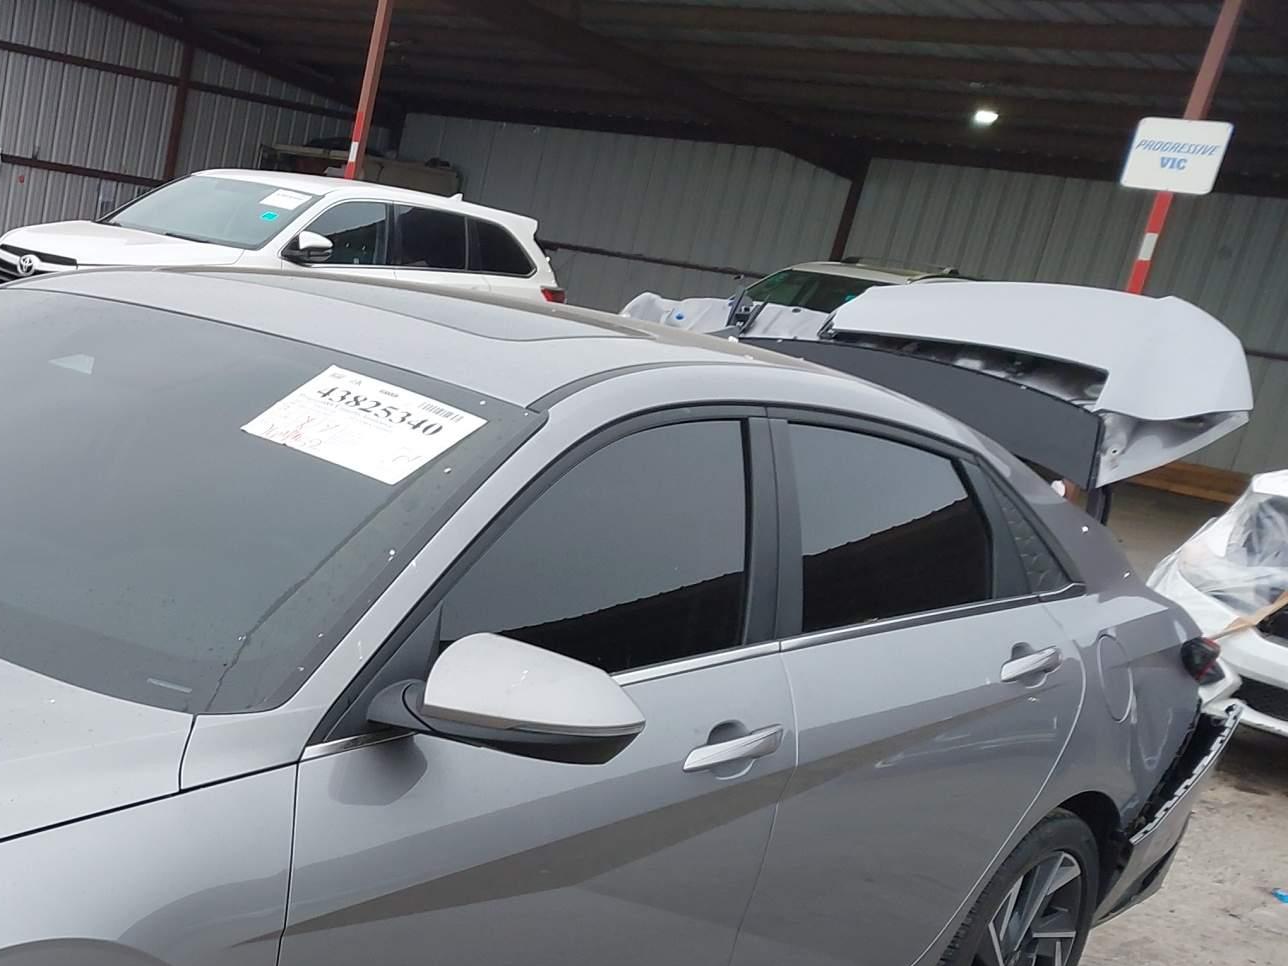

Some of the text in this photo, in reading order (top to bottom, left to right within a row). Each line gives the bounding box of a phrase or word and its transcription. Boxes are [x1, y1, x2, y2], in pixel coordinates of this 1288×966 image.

[1136, 139, 1221, 156] PROGRESSIVE
[1159, 156, 1188, 171] VIC
[316, 386, 444, 436] 43825340
